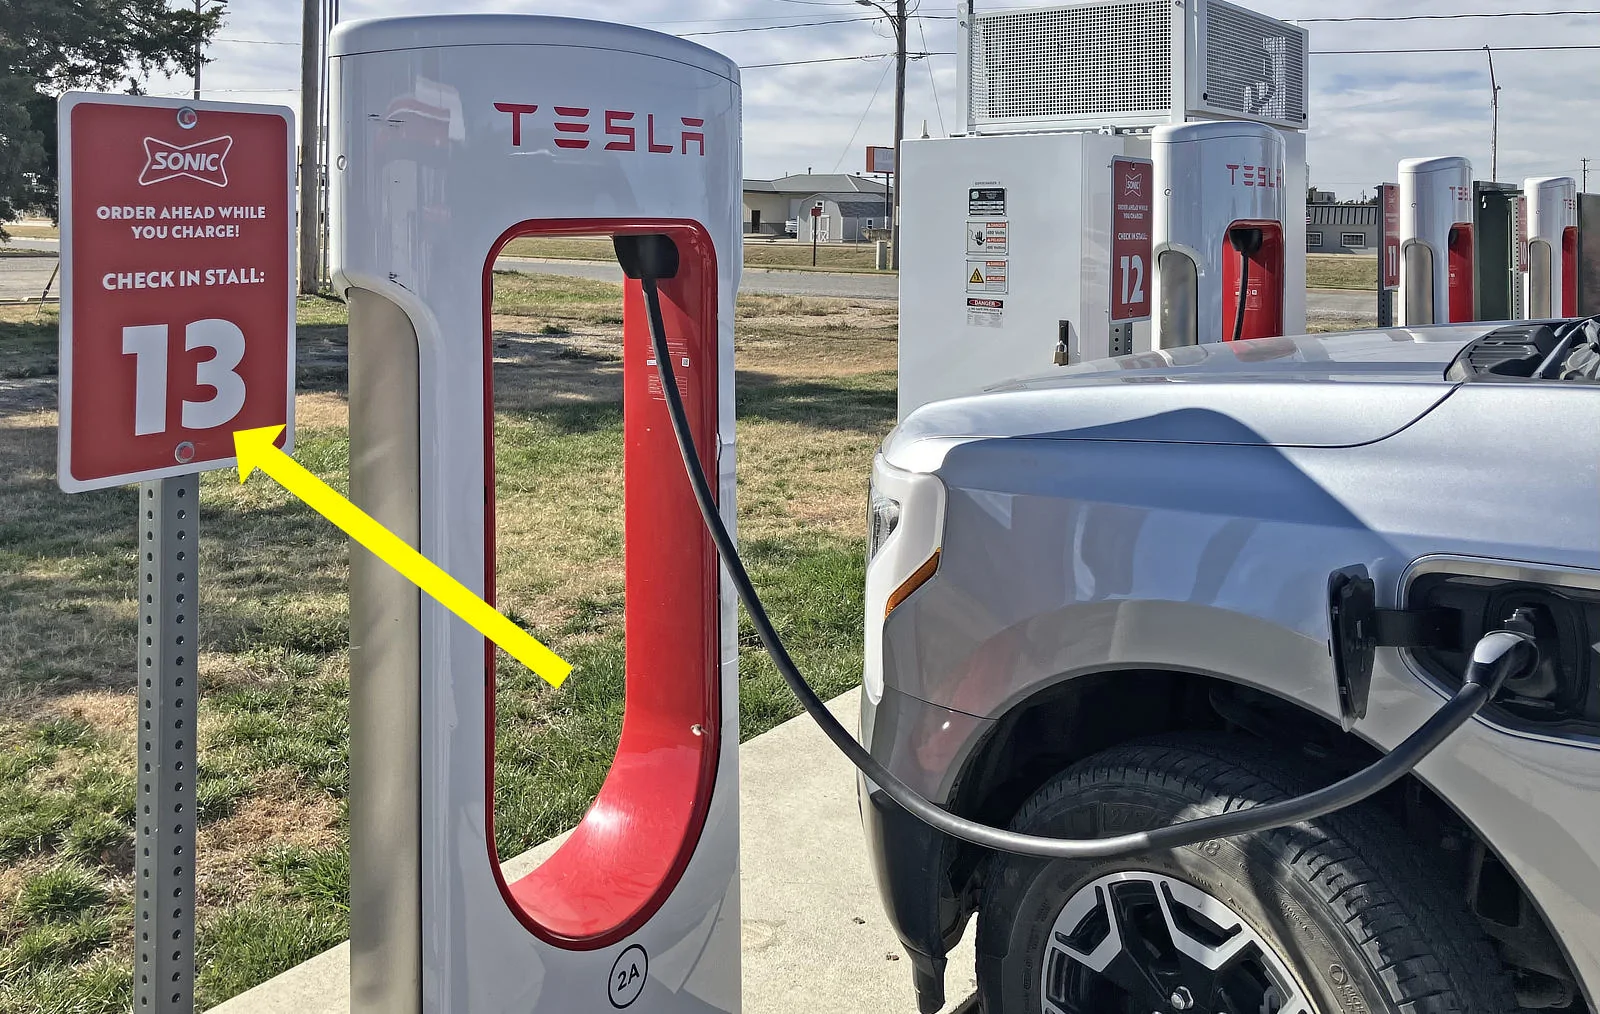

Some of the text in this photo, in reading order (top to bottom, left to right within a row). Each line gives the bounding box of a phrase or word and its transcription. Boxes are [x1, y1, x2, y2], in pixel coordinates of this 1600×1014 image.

[493, 102, 704, 156] TESLA
[151, 152, 219, 171] SONIC
[1127, 180, 1140, 190] SONIC
[1225, 164, 1282, 189] TESLA
[96, 206, 266, 220] ORDER AHEAD WHILE
[131, 225, 240, 239] YOU CHARGE!
[1118, 232, 1131, 240] CHECK
[1388, 245, 1397, 277] 11
[102, 268, 265, 290] CHECK IN STALL:
[1120, 254, 1144, 305] 12
[122, 318, 247, 436] 13
[618, 964, 639, 991] 2A
